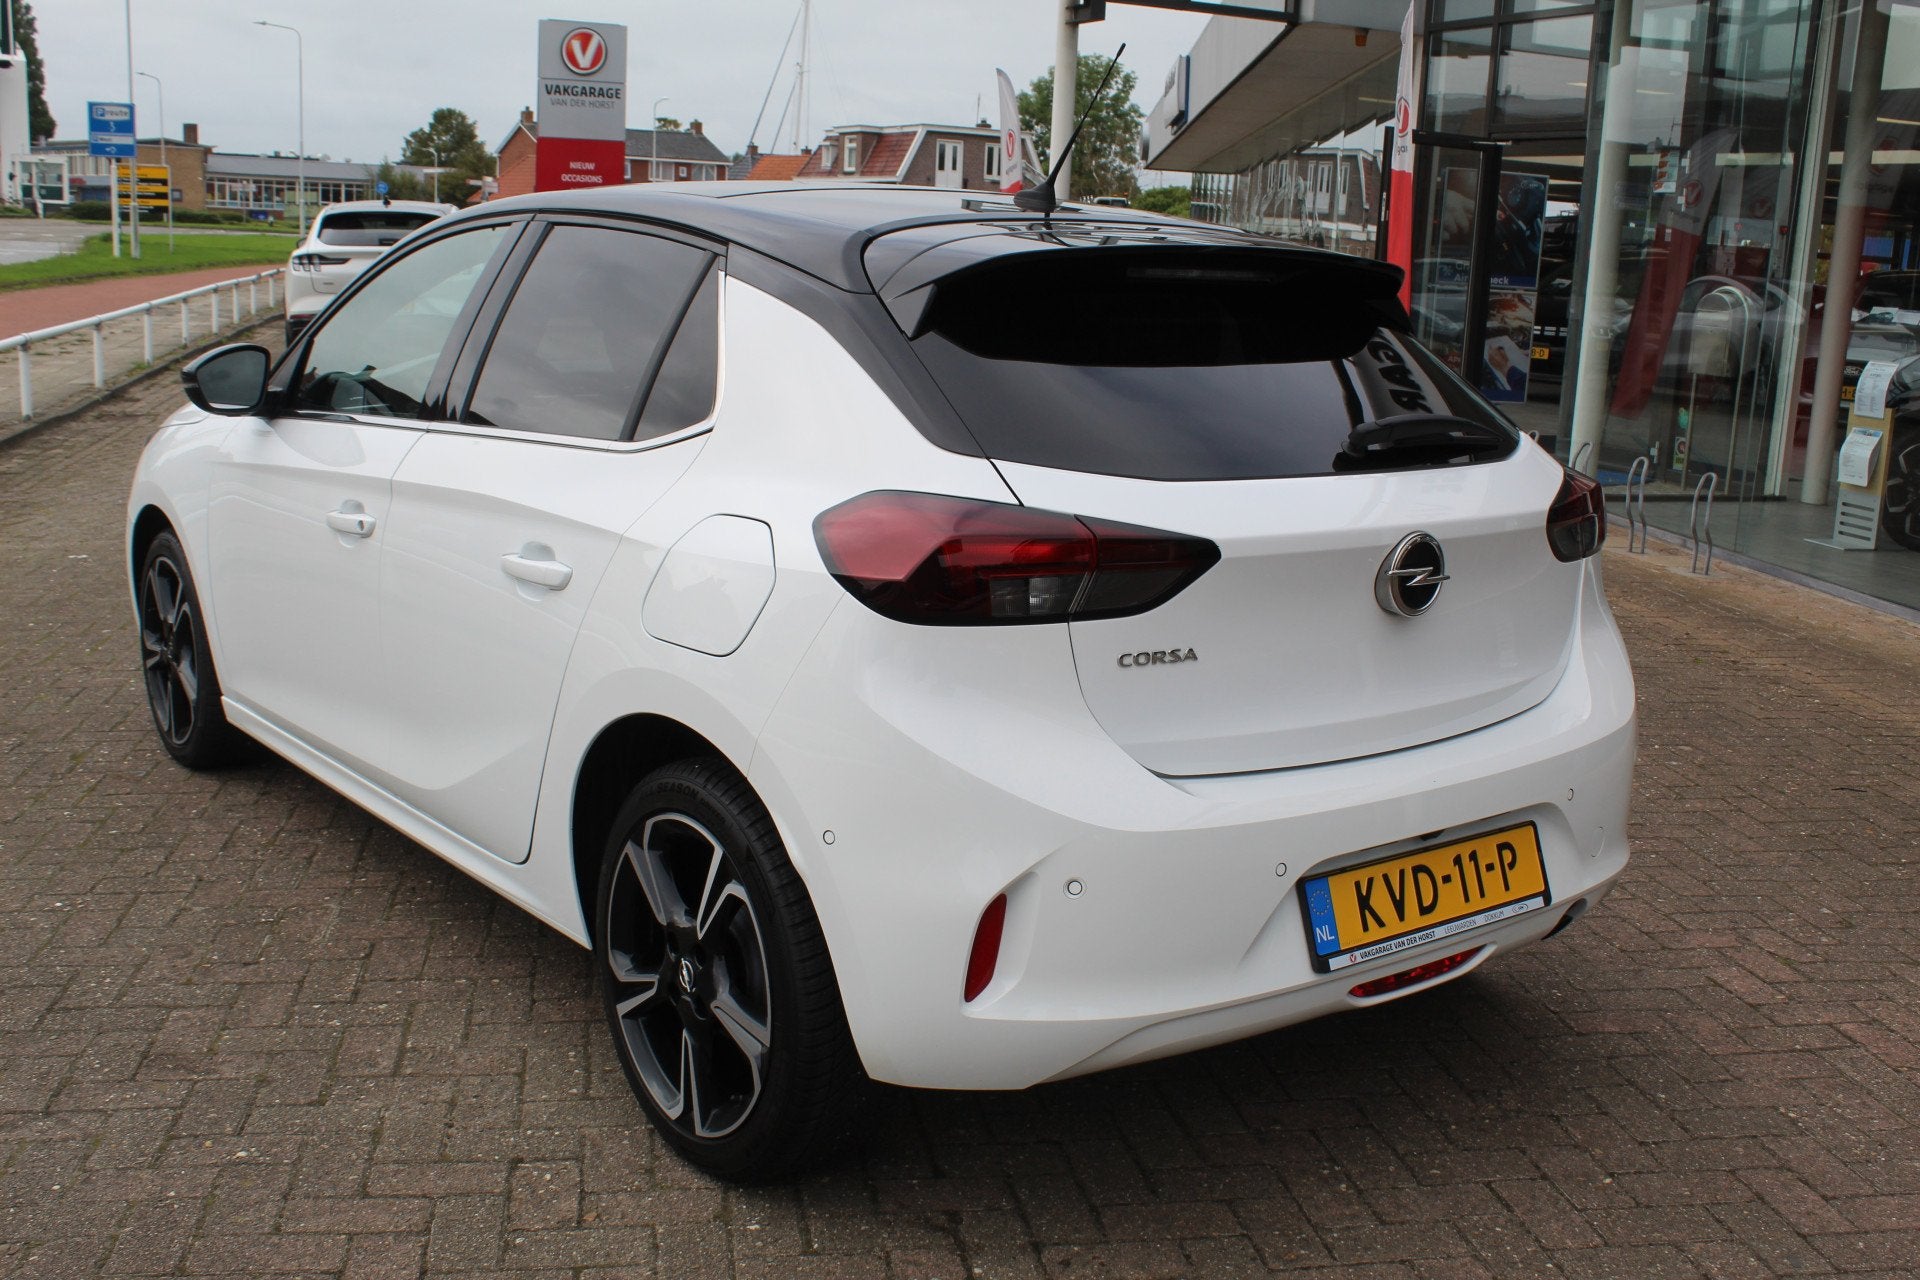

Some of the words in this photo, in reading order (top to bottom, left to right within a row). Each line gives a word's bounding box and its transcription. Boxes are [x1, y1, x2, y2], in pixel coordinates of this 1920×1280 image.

[545, 84, 622, 99] VAKGARAGE
[550, 98, 568, 106] VAN
[570, 99, 587, 108] DER
[588, 100, 616, 109] HORST
[570, 161, 595, 170] NIEUW
[561, 173, 603, 183] OCCASIONS
[1117, 647, 1198, 667] CORSA
[1354, 842, 1517, 933] KVD-11-P
[1315, 924, 1335, 943] NL
[1360, 944, 1393, 959] VAKGARAGE
[1394, 939, 1405, 949] VAN
[1406, 936, 1417, 946] DER
[1418, 931, 1435, 943] HORST
[1444, 919, 1477, 935] LEEUWARDEN
